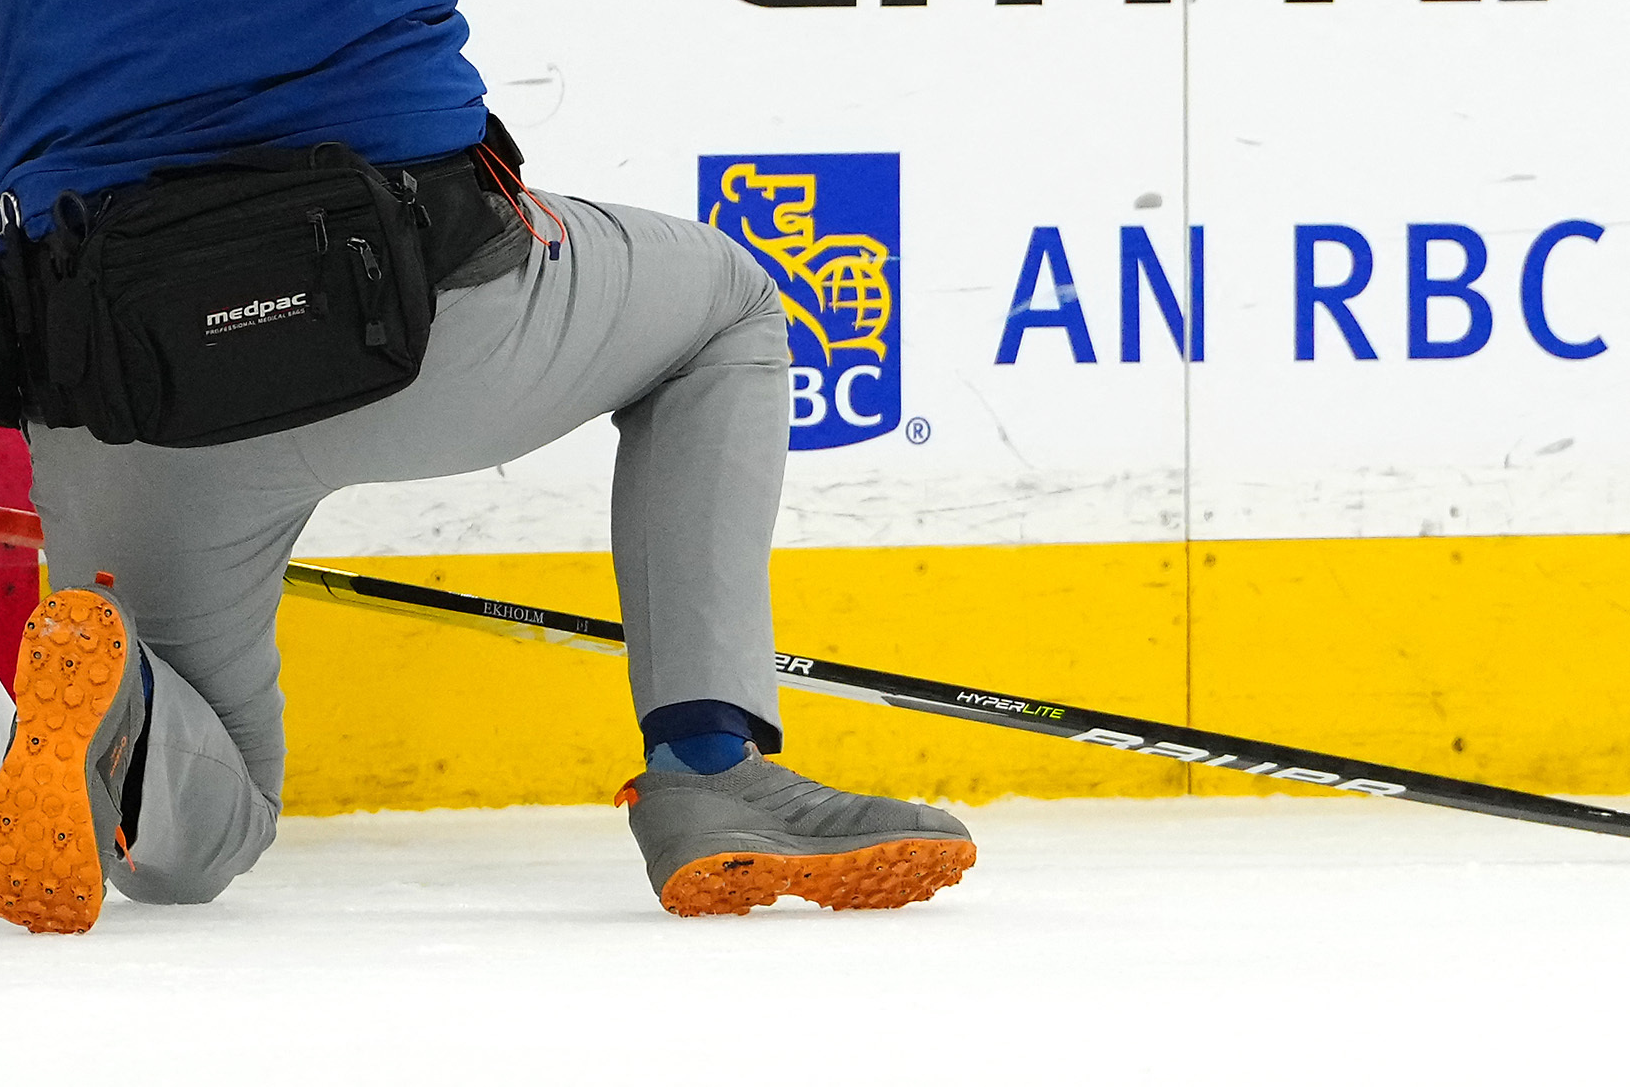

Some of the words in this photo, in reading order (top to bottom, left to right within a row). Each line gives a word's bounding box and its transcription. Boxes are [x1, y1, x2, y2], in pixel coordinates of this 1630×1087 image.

[993, 225, 1205, 364] AN
[1293, 219, 1608, 361] RBC
[207, 293, 307, 326] medpac
[788, 366, 883, 427] BC
[483, 601, 545, 625] EKHOLM
[956, 691, 1066, 720] HYPERLITE
